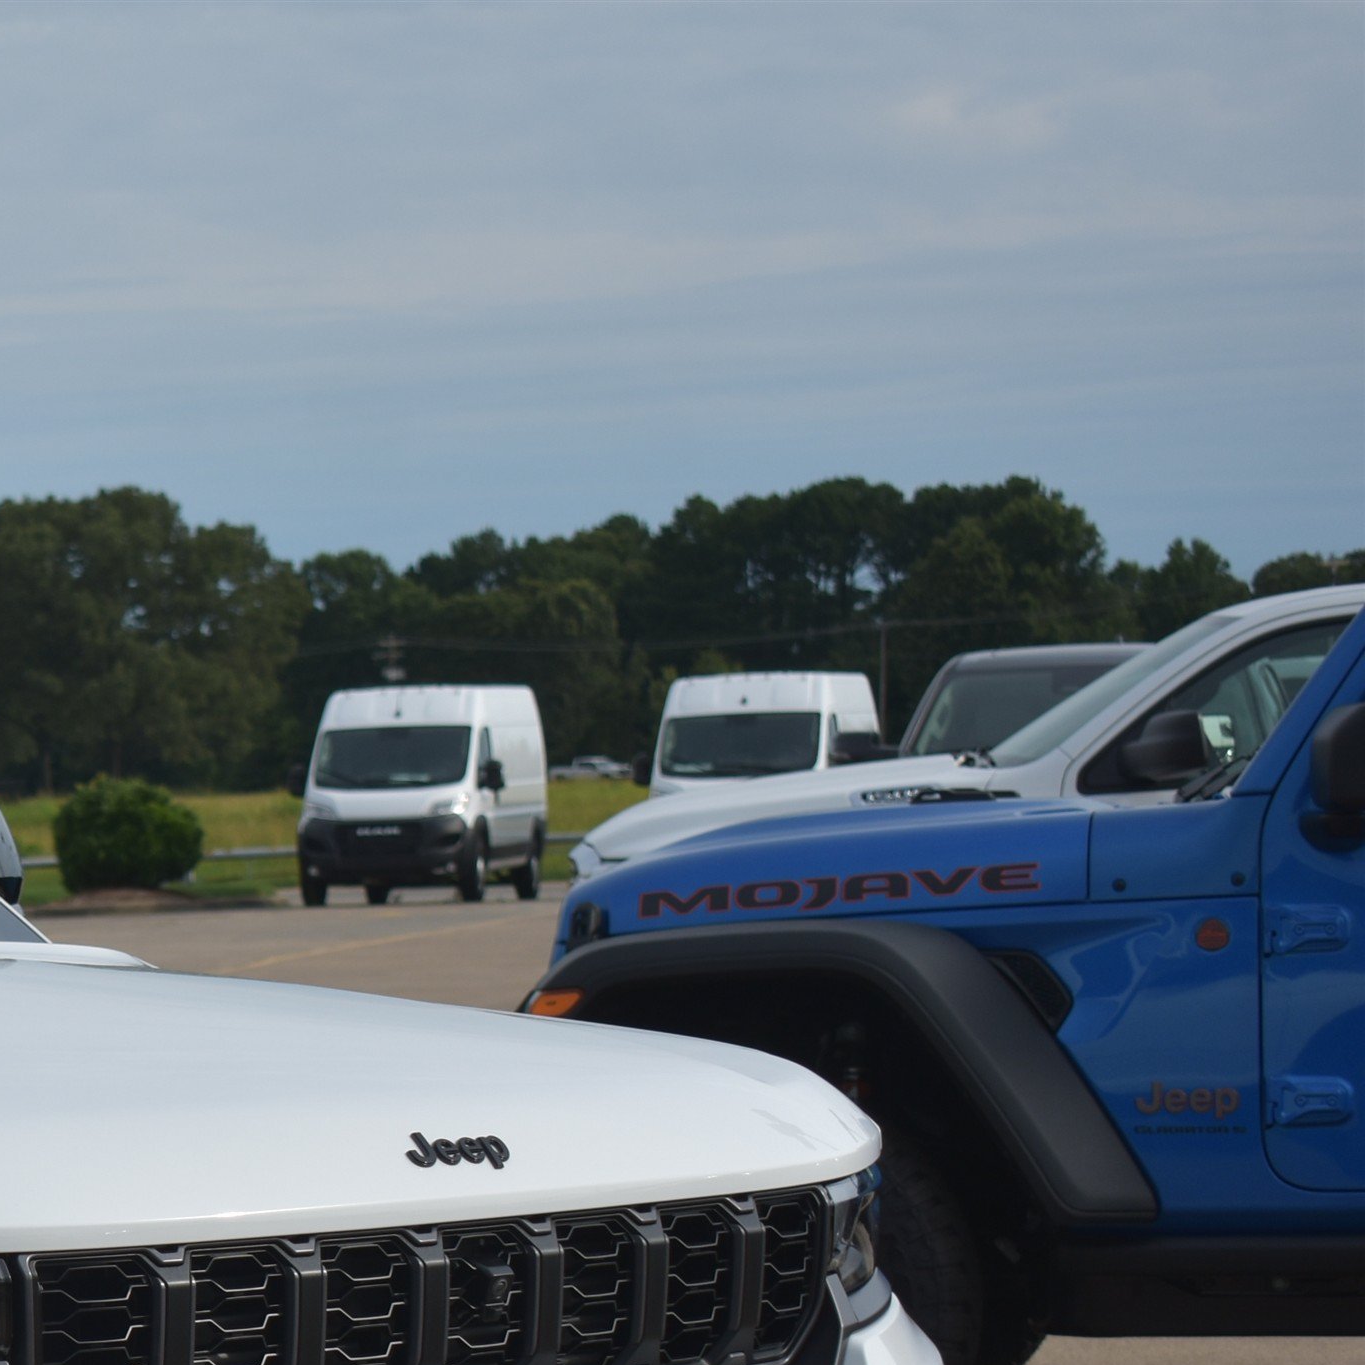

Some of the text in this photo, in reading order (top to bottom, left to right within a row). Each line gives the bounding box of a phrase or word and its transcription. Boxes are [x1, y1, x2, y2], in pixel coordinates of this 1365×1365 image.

[637, 862, 1041, 919] MOJAVE
[1135, 1081, 1241, 1120] Jeep
[405, 1131, 511, 1170] Jeep
